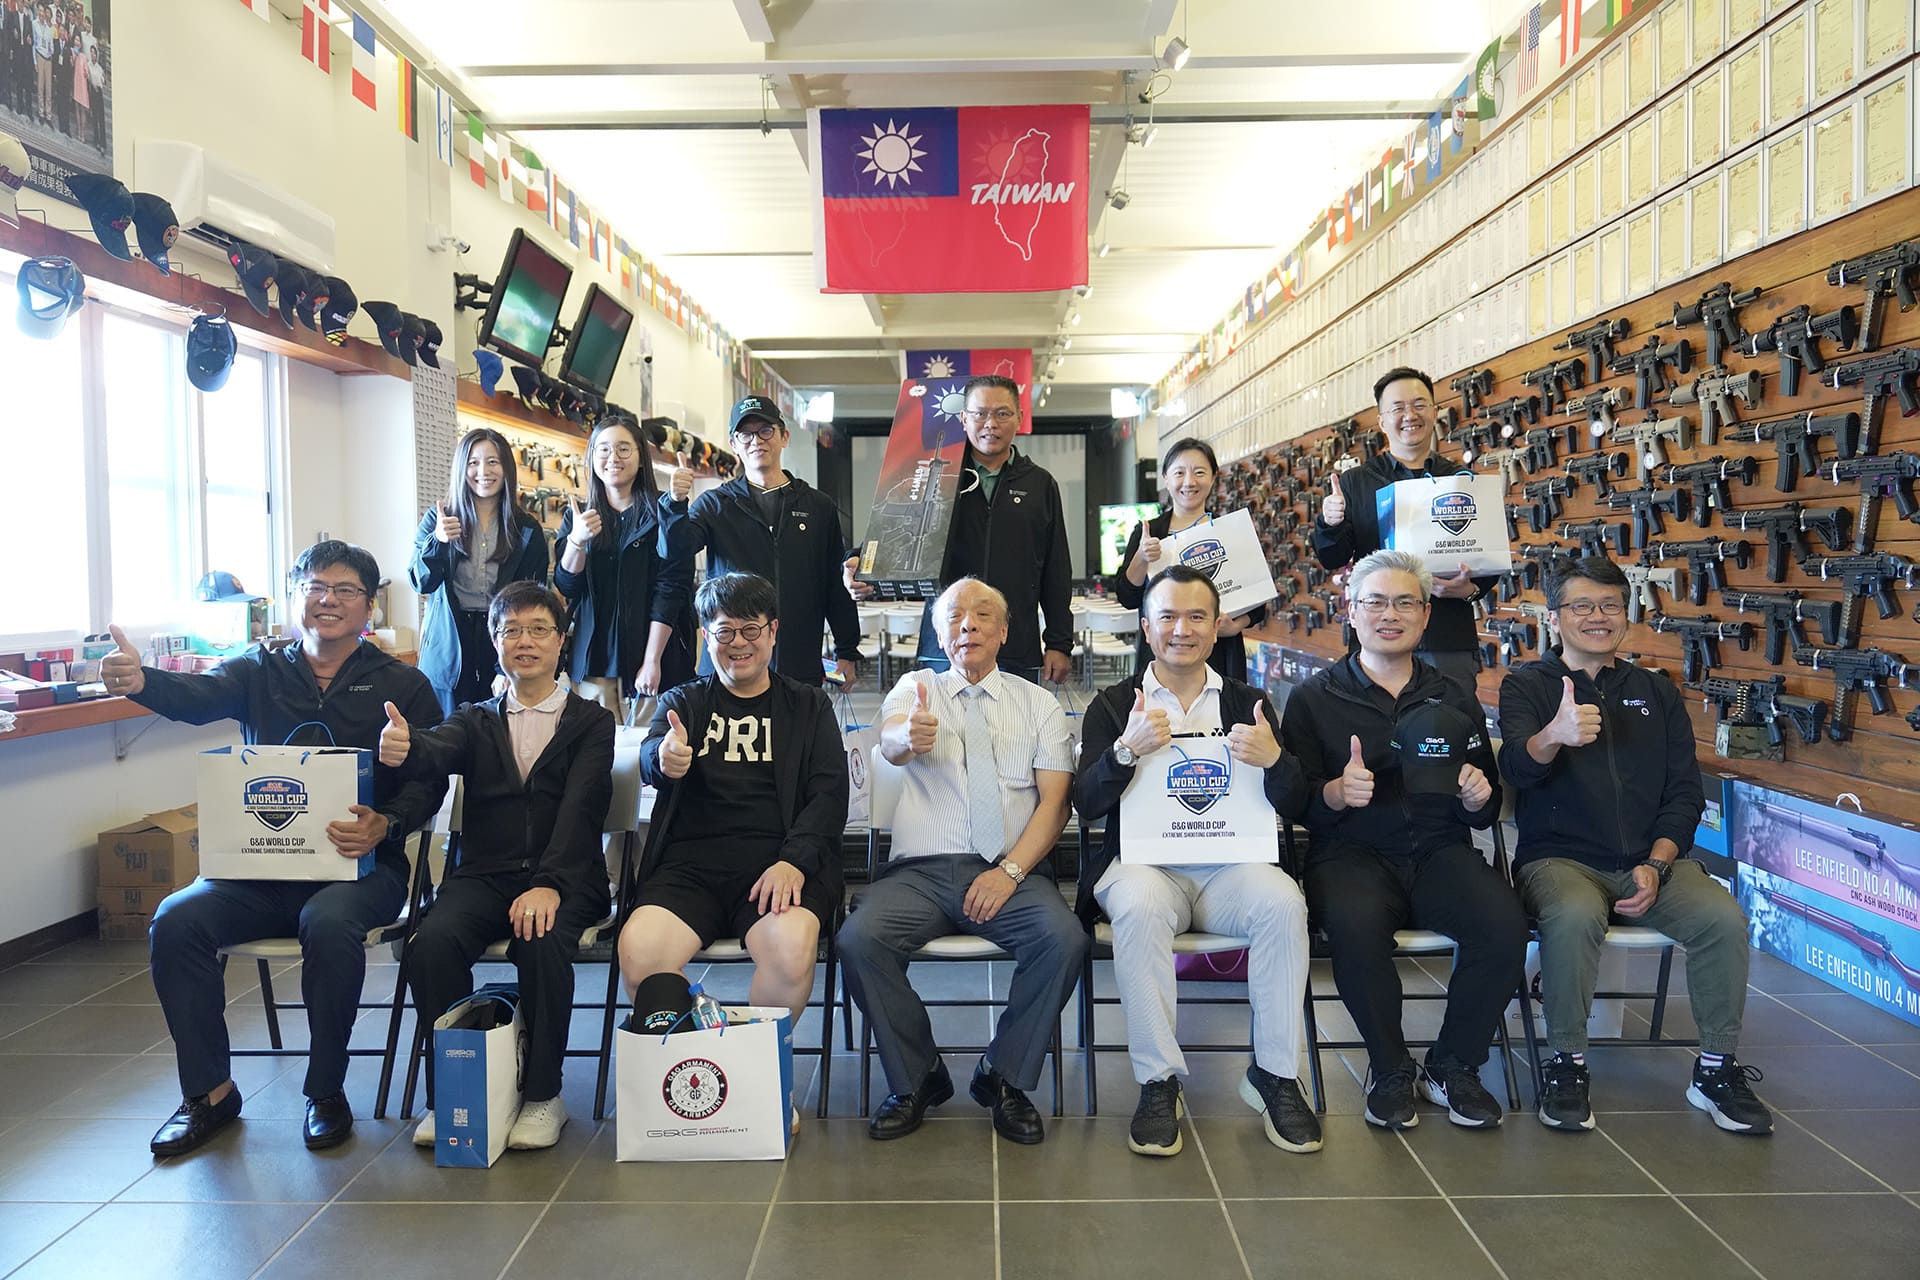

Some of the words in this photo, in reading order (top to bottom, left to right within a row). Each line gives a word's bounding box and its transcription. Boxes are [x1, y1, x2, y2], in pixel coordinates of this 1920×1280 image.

[971, 182, 1075, 205] TAIWAN
[1435, 505, 1461, 515] WORLD
[1462, 504, 1476, 514] CUP
[1435, 540, 1447, 549] G&G
[1447, 540, 1465, 548] WORLD
[1466, 539, 1476, 547] CUP
[1183, 552, 1210, 567] WORLD
[1210, 548, 1225, 559] CUP
[1222, 579, 1234, 589] CUP
[1418, 744, 1450, 753] W.T.S
[1170, 777, 1207, 788] WORLD
[1209, 776, 1228, 787] CUP
[247, 794, 284, 804] WORLD
[286, 794, 306, 804] CUP
[1172, 821, 1186, 830] G&G
[1187, 821, 1211, 830] WORLD
[1212, 820, 1226, 830] CUP
[250, 837, 265, 847] G&G
[266, 837, 290, 847] WORLD
[291, 837, 306, 847] CUP
[1795, 848, 1813, 872] LEE
[1816, 855, 1860, 889] ENFIELD
[1863, 872, 1891, 900] NO.4
[1850, 889, 1863, 903] CNC
[1864, 893, 1877, 908] ASH
[1878, 901, 1896, 917] WOOD
[1896, 906, 1919, 923] STOCK
[1806, 944, 1825, 970] LEE
[1827, 954, 1872, 993] ENFIELD
[1875, 975, 1903, 1008] NO.4
[667, 1066, 681, 1081] G&G
[681, 1060, 722, 1077] ARMAMENT
[683, 1096, 724, 1118] ARMAMENT
